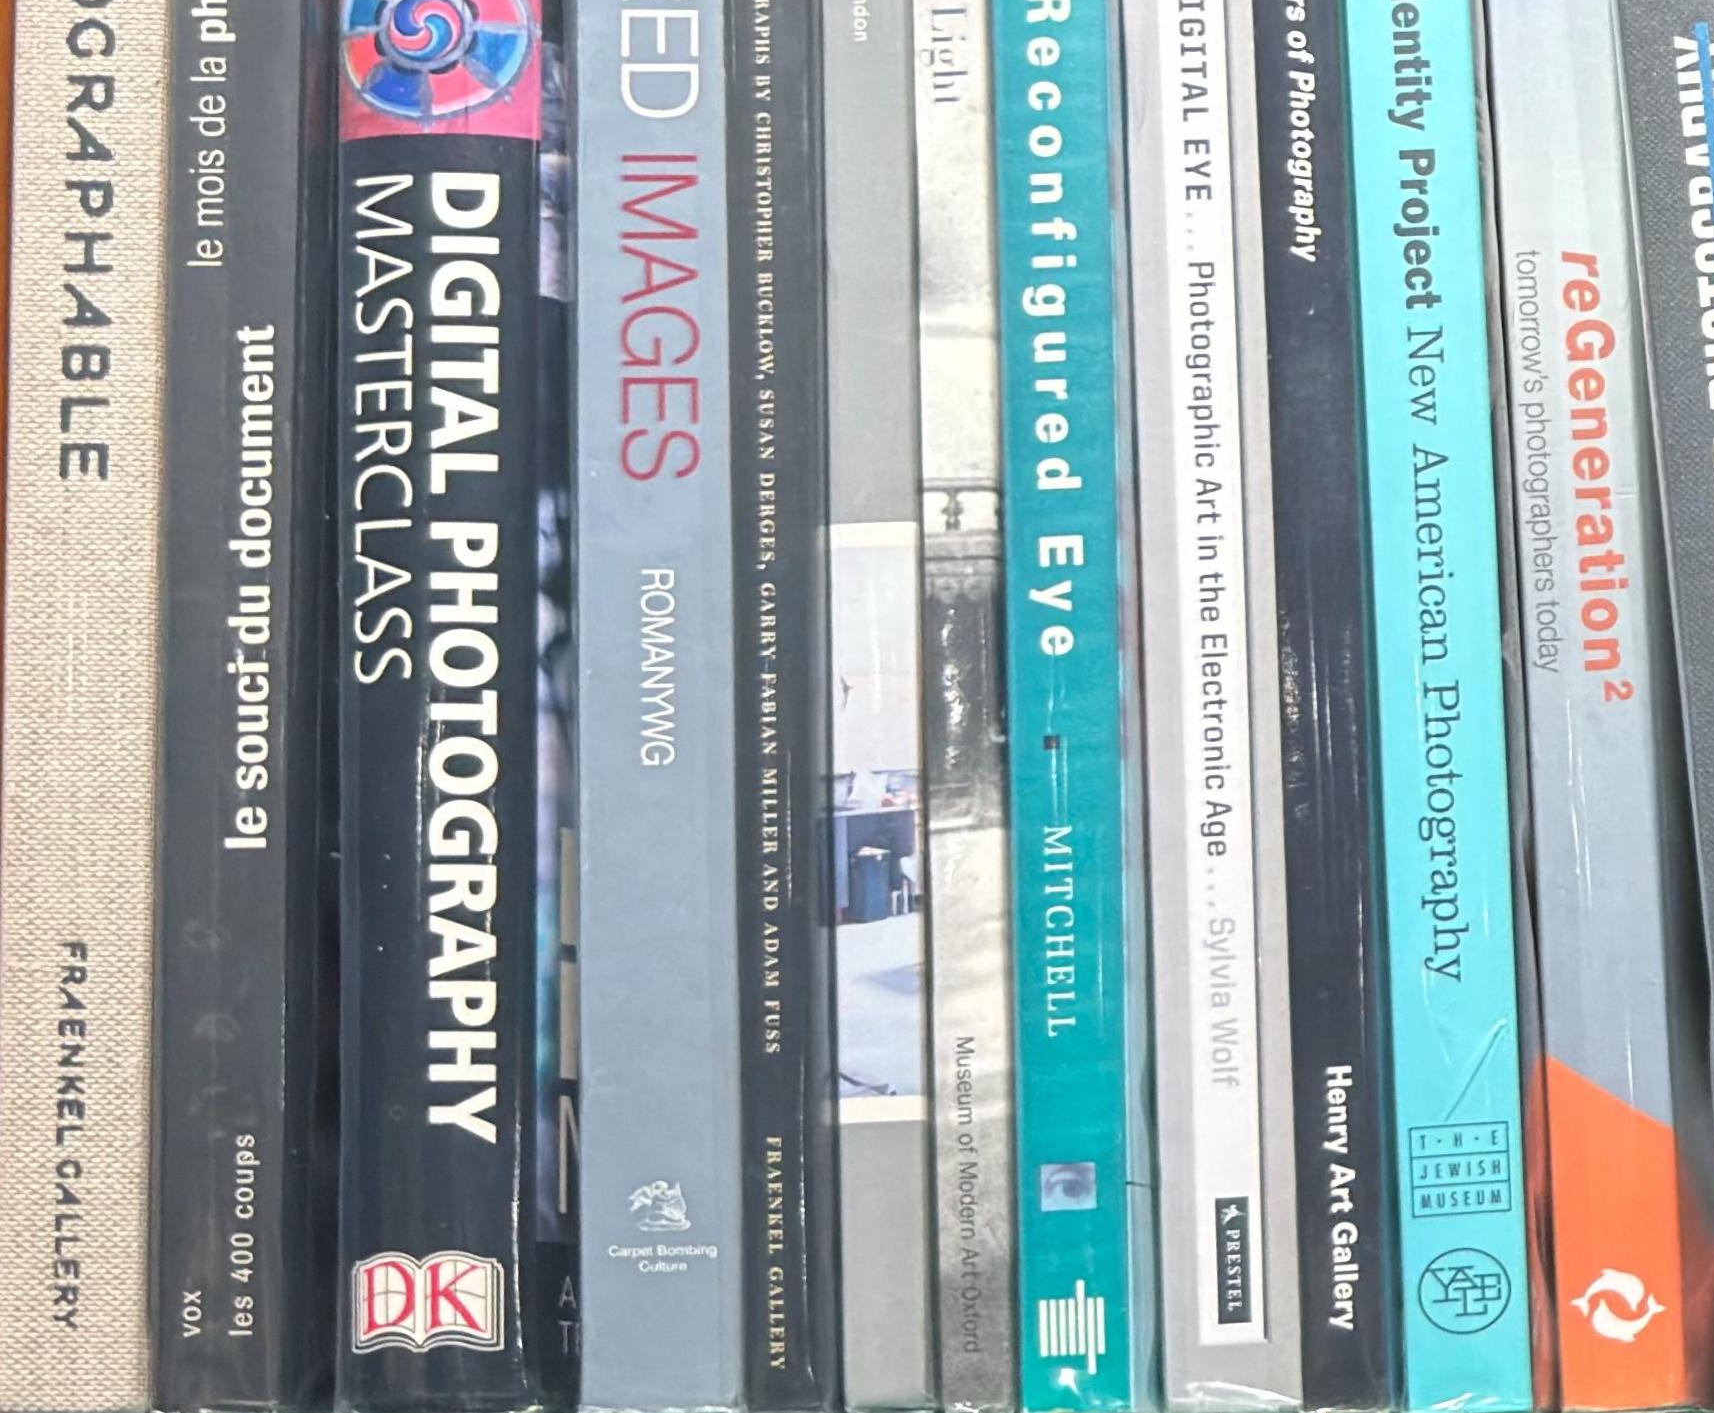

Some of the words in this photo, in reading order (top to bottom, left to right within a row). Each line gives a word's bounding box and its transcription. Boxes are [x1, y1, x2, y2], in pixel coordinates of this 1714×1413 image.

[1393, 148, 1443, 312] Project
[428, 172, 501, 496] DIGITAL
[620, 154, 700, 482] IMAGES
[1406, 326, 1446, 426] New
[229, 324, 273, 576] document
[355, 174, 414, 685] MASTERCLASS
[1519, 402, 1556, 593] photographers
[1029, 534, 1084, 657] Eye
[1412, 444, 1454, 666] American
[227, 588, 269, 646] du
[639, 567, 675, 768] ROMANYWG
[1532, 600, 1561, 672] today
[226, 661, 267, 801] souci
[226, 813, 266, 850] le
[428, 522, 500, 1143] PHOTOGRAPHY
[1418, 681, 1469, 984] Photography
[1043, 825, 1079, 1038] MITCHELL
[57, 940, 89, 1145] FRAENKEL
[1325, 1065, 1352, 1156] Henry
[232, 1132, 258, 1207] coups
[1328, 1161, 1355, 1224] Art
[1419, 1158, 1503, 1179] JEWISH
[1420, 1187, 1505, 1209] MUSEUM
[53, 1149, 84, 1332] GALLERY
[229, 1221, 256, 1282] 400
[608, 1243, 652, 1257] Carpet
[657, 1243, 718, 1258] Bombing
[639, 1259, 688, 1272] Culture
[1226, 1228, 1244, 1314] PRESTEL
[1329, 1227, 1358, 1331] Gallery
[183, 1288, 202, 1337] vox
[230, 1293, 254, 1336] les
[359, 1258, 486, 1340] DK
